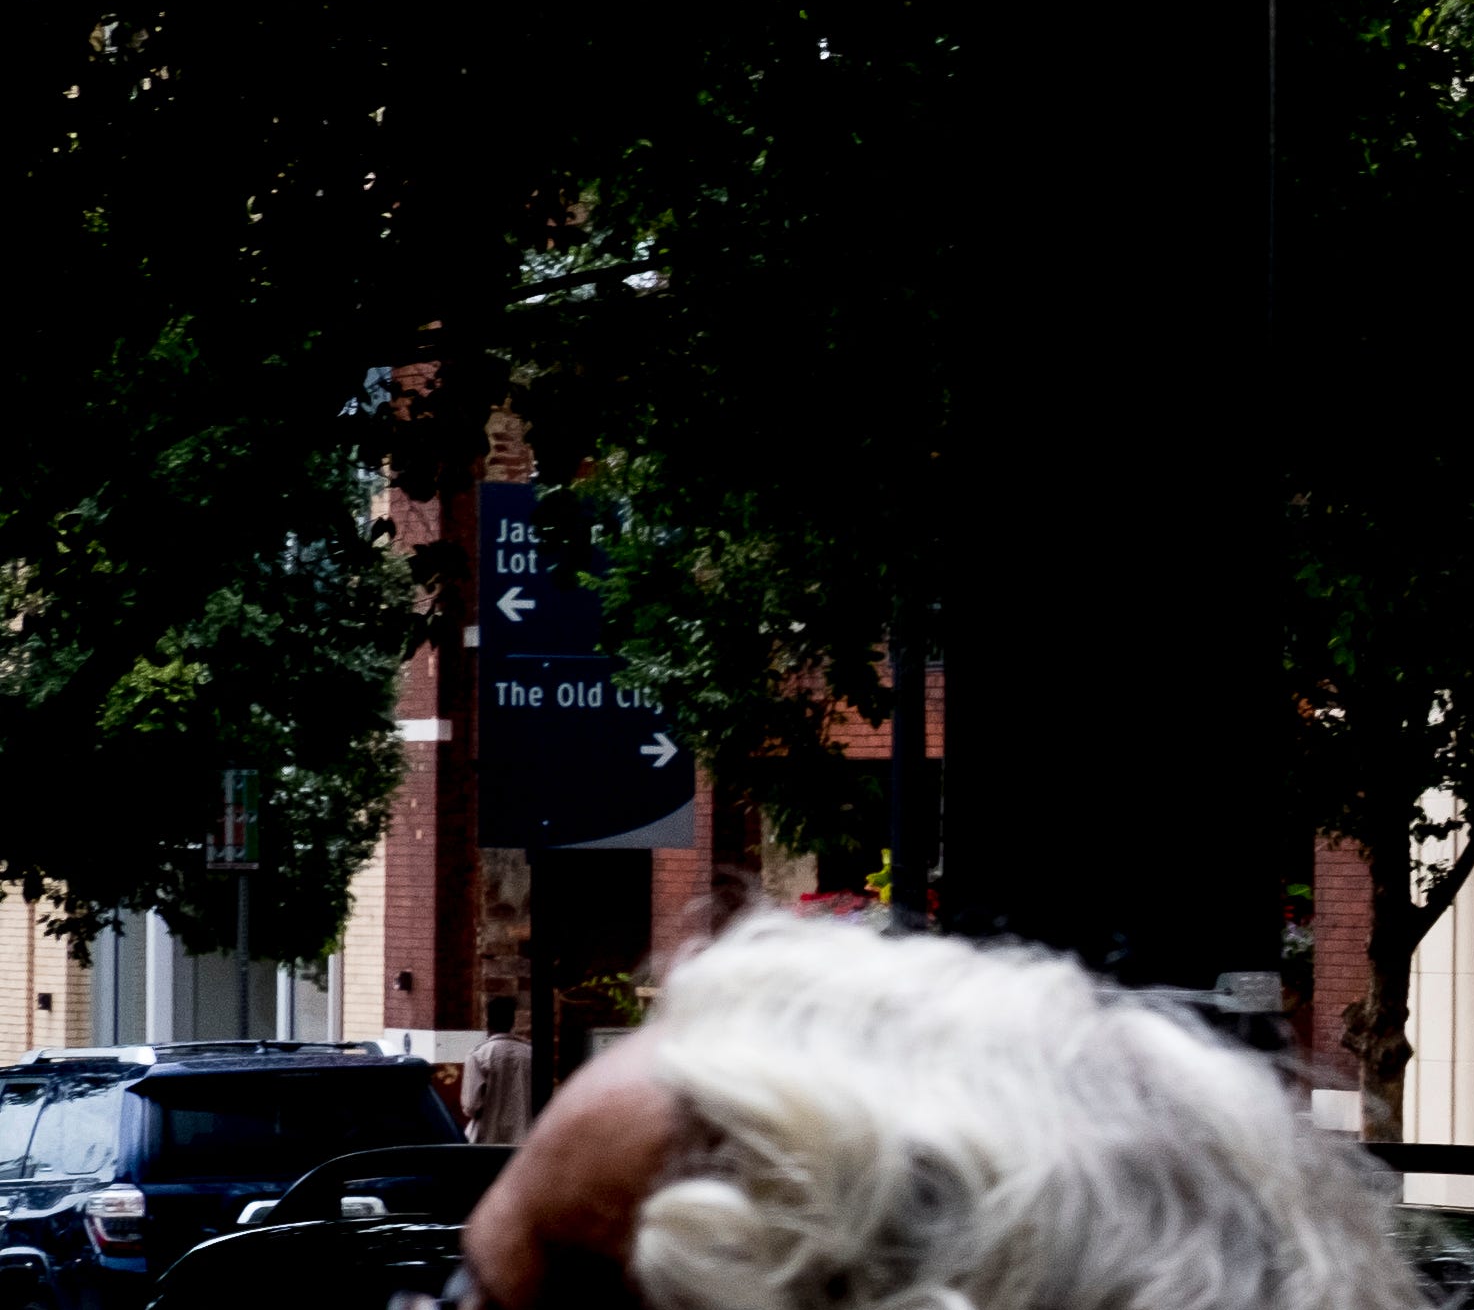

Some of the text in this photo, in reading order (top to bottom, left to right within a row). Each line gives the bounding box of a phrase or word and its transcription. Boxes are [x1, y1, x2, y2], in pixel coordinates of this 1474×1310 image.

[496, 549, 538, 573] Lot
[496, 681, 543, 707] The
[557, 681, 602, 707] Old
